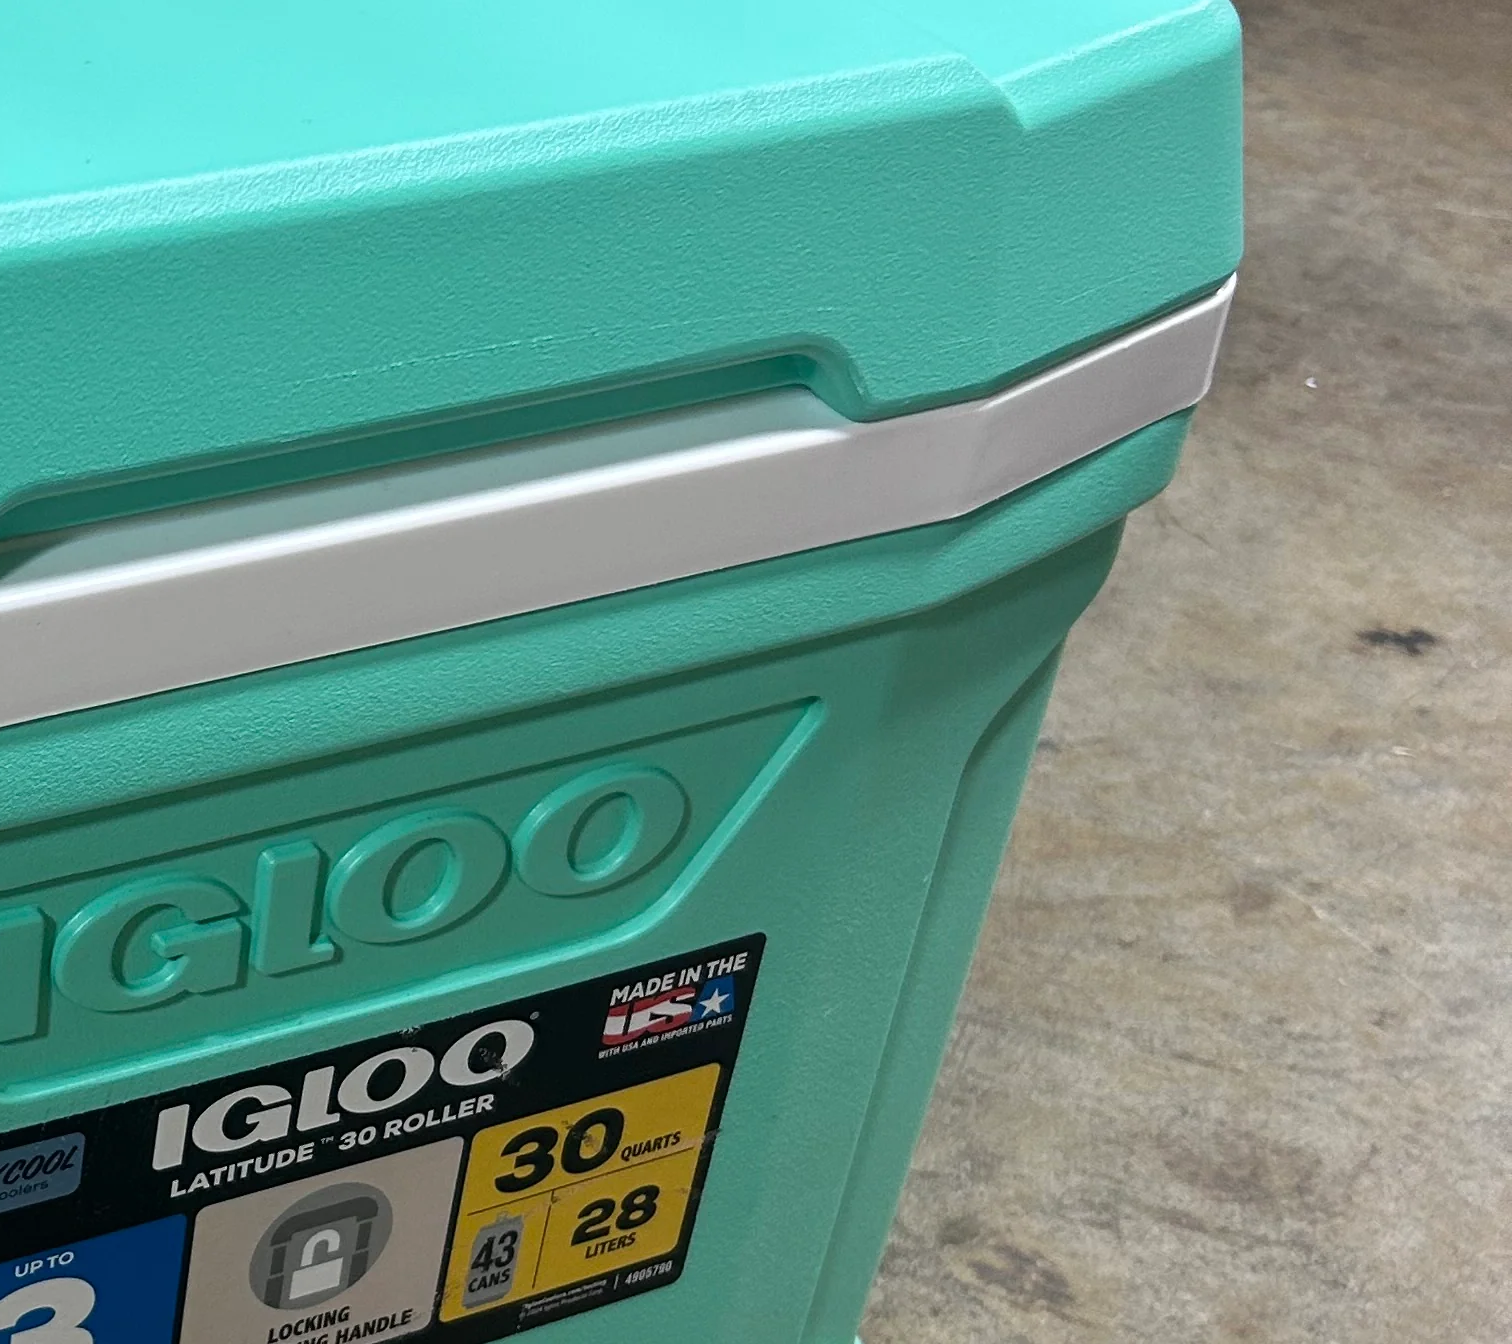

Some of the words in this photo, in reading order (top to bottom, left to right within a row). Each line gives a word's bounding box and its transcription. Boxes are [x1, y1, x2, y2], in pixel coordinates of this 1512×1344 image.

[610, 972, 676, 1006] MADE
[678, 964, 702, 987] IN
[706, 951, 748, 979] THE
[602, 974, 735, 1046] USA
[598, 1046, 620, 1059] WITH
[622, 1041, 638, 1054] USA
[640, 1035, 659, 1048] AND
[660, 1022, 705, 1041] IMPORTED
[705, 1014, 733, 1029] PARTS
[152, 1019, 535, 1171] IGLOO
[170, 1141, 315, 1198] LATITUDE
[338, 1126, 377, 1151] 30
[383, 1093, 496, 1139] ROLLER
[494, 1107, 625, 1194] 30
[620, 1131, 682, 1162] QUARTS
[570, 1184, 661, 1248] 28
[14, 1259, 43, 1278] UP
[46, 1251, 75, 1269] TO
[470, 1230, 519, 1272] 43
[585, 1232, 637, 1260] LITERS
[468, 1268, 511, 1294] CANS
[266, 1306, 351, 1344] LOCKING
